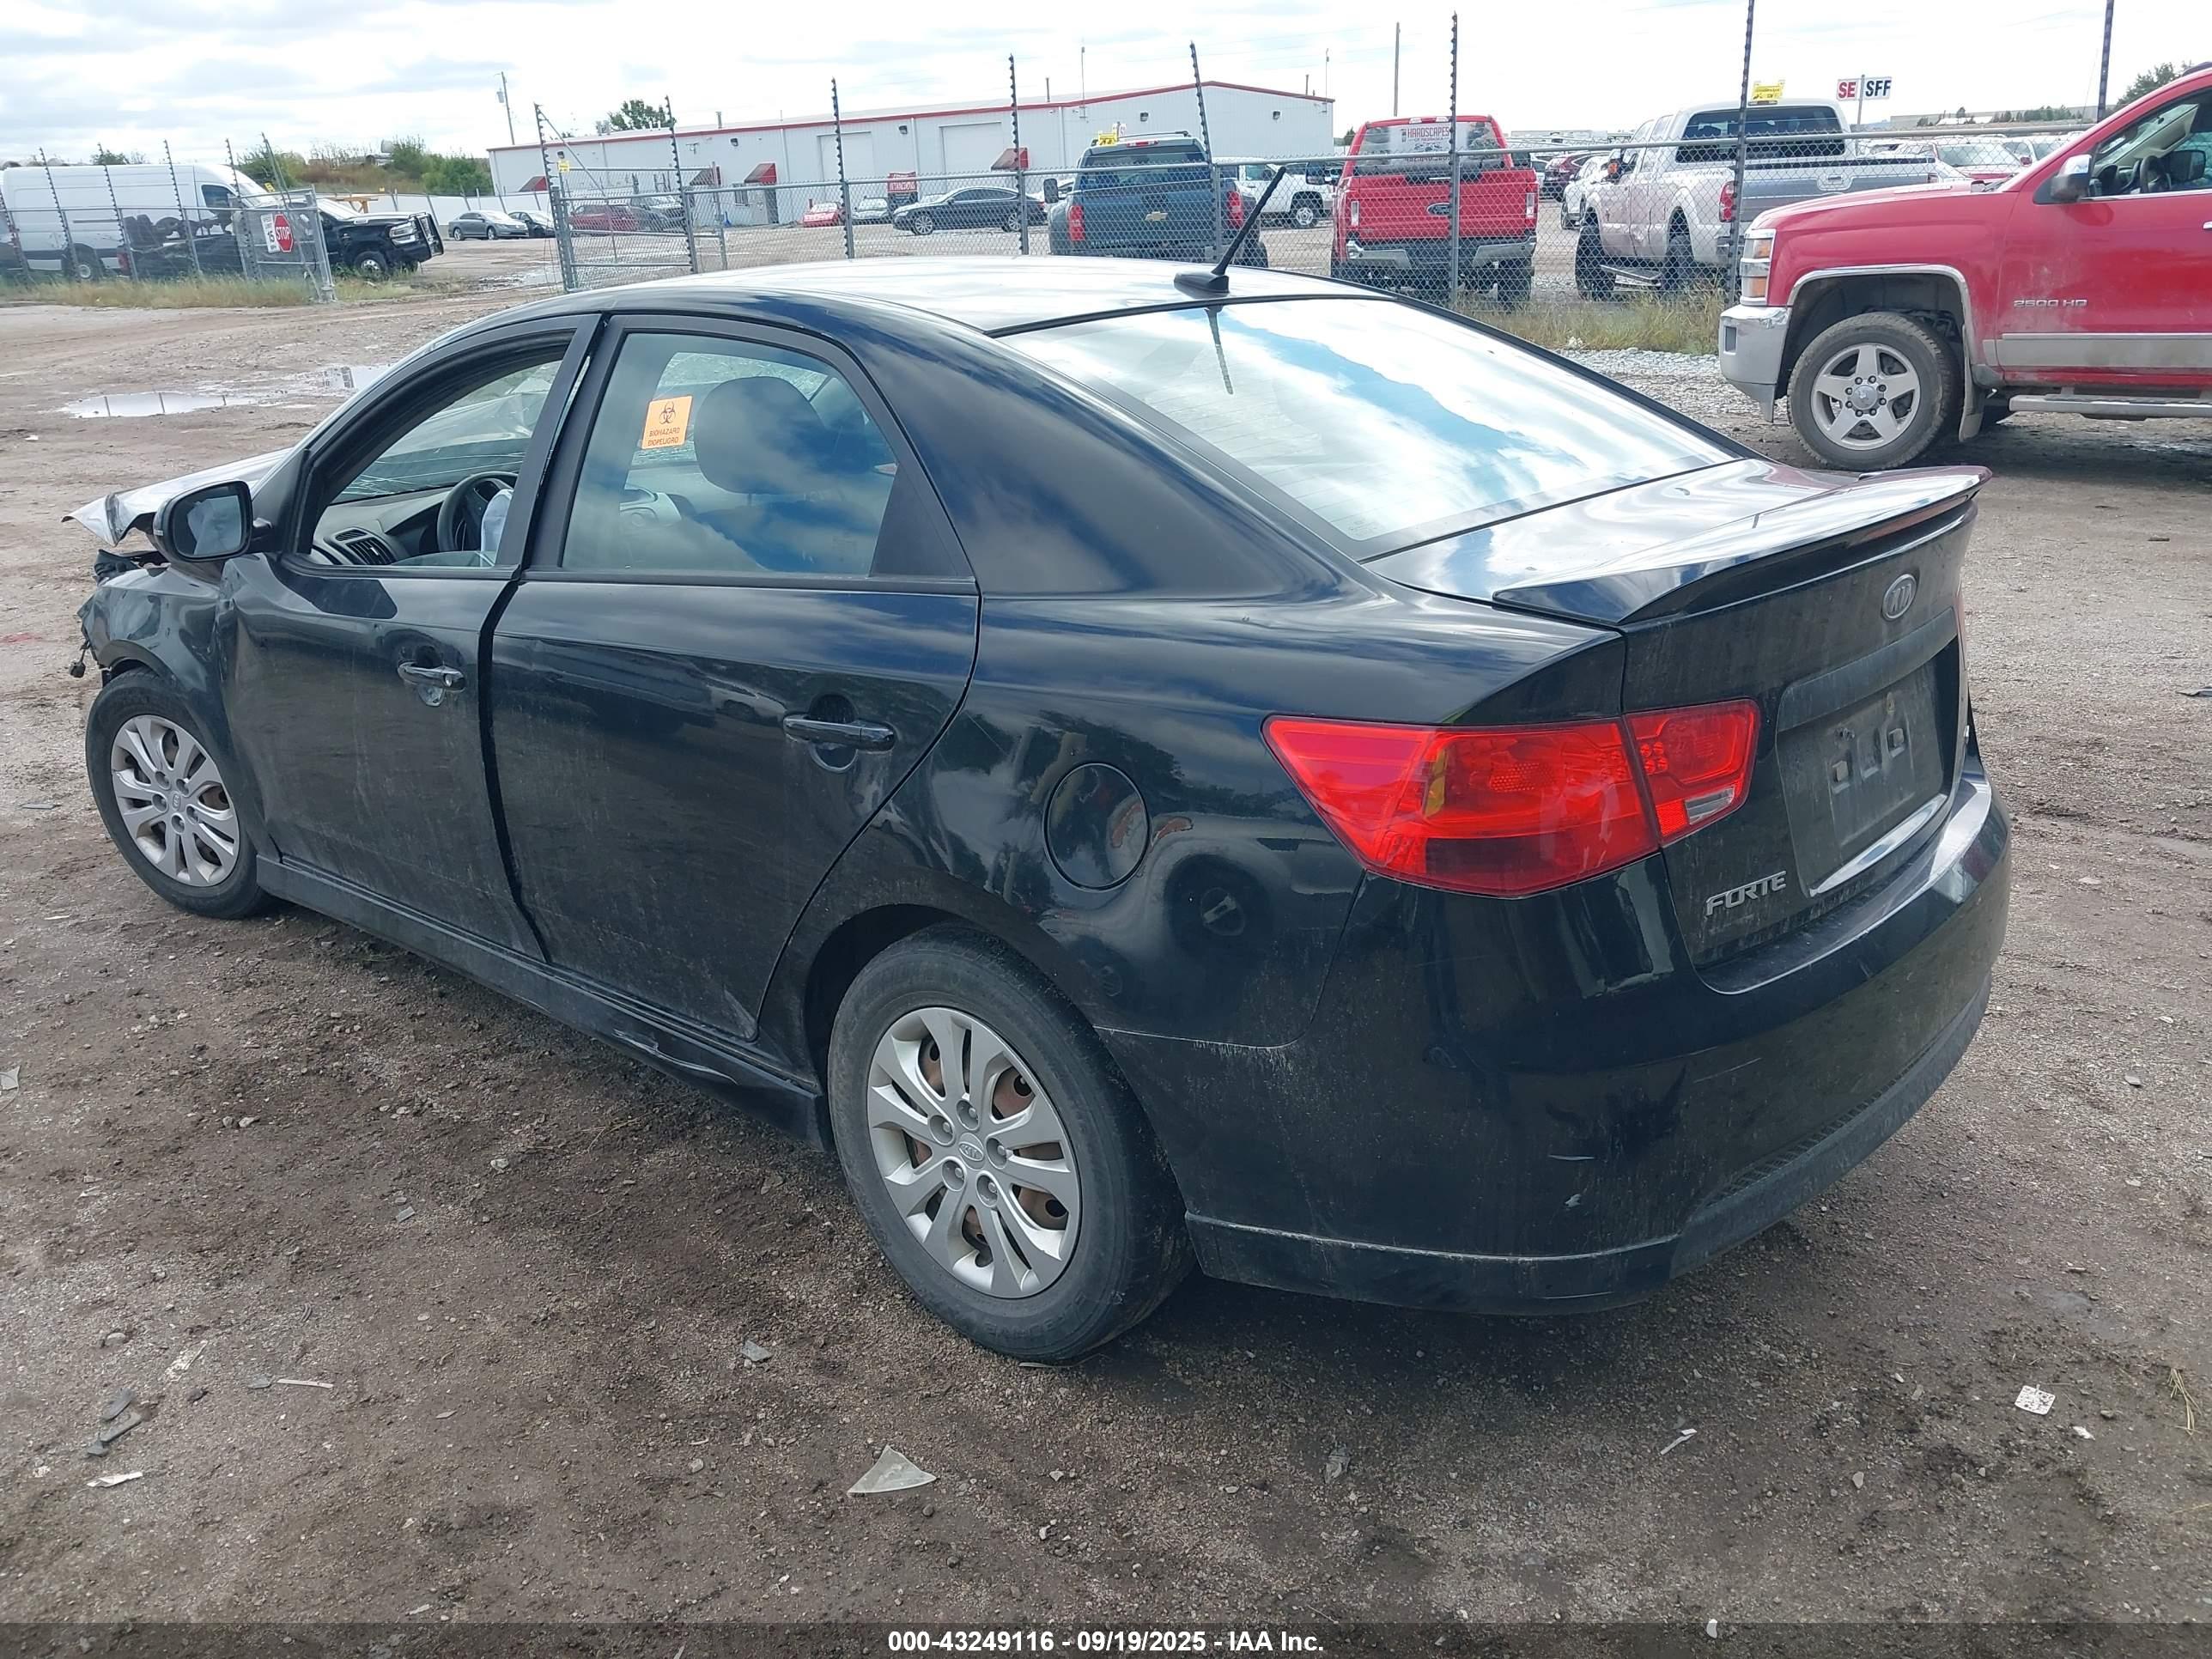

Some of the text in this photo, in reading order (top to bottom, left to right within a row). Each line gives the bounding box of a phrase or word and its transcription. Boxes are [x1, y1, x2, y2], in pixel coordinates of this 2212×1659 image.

[1838, 82, 1856, 99] SE
[1407, 126, 1449, 137] HARDSCAPES
[276, 226, 291, 240] STOP
[2014, 299, 2087, 307] 2500 HD
[649, 427, 680, 436] BIOHAZARD
[647, 436, 679, 446] BIOPELIGRO
[1705, 870, 1787, 916] FORTE
